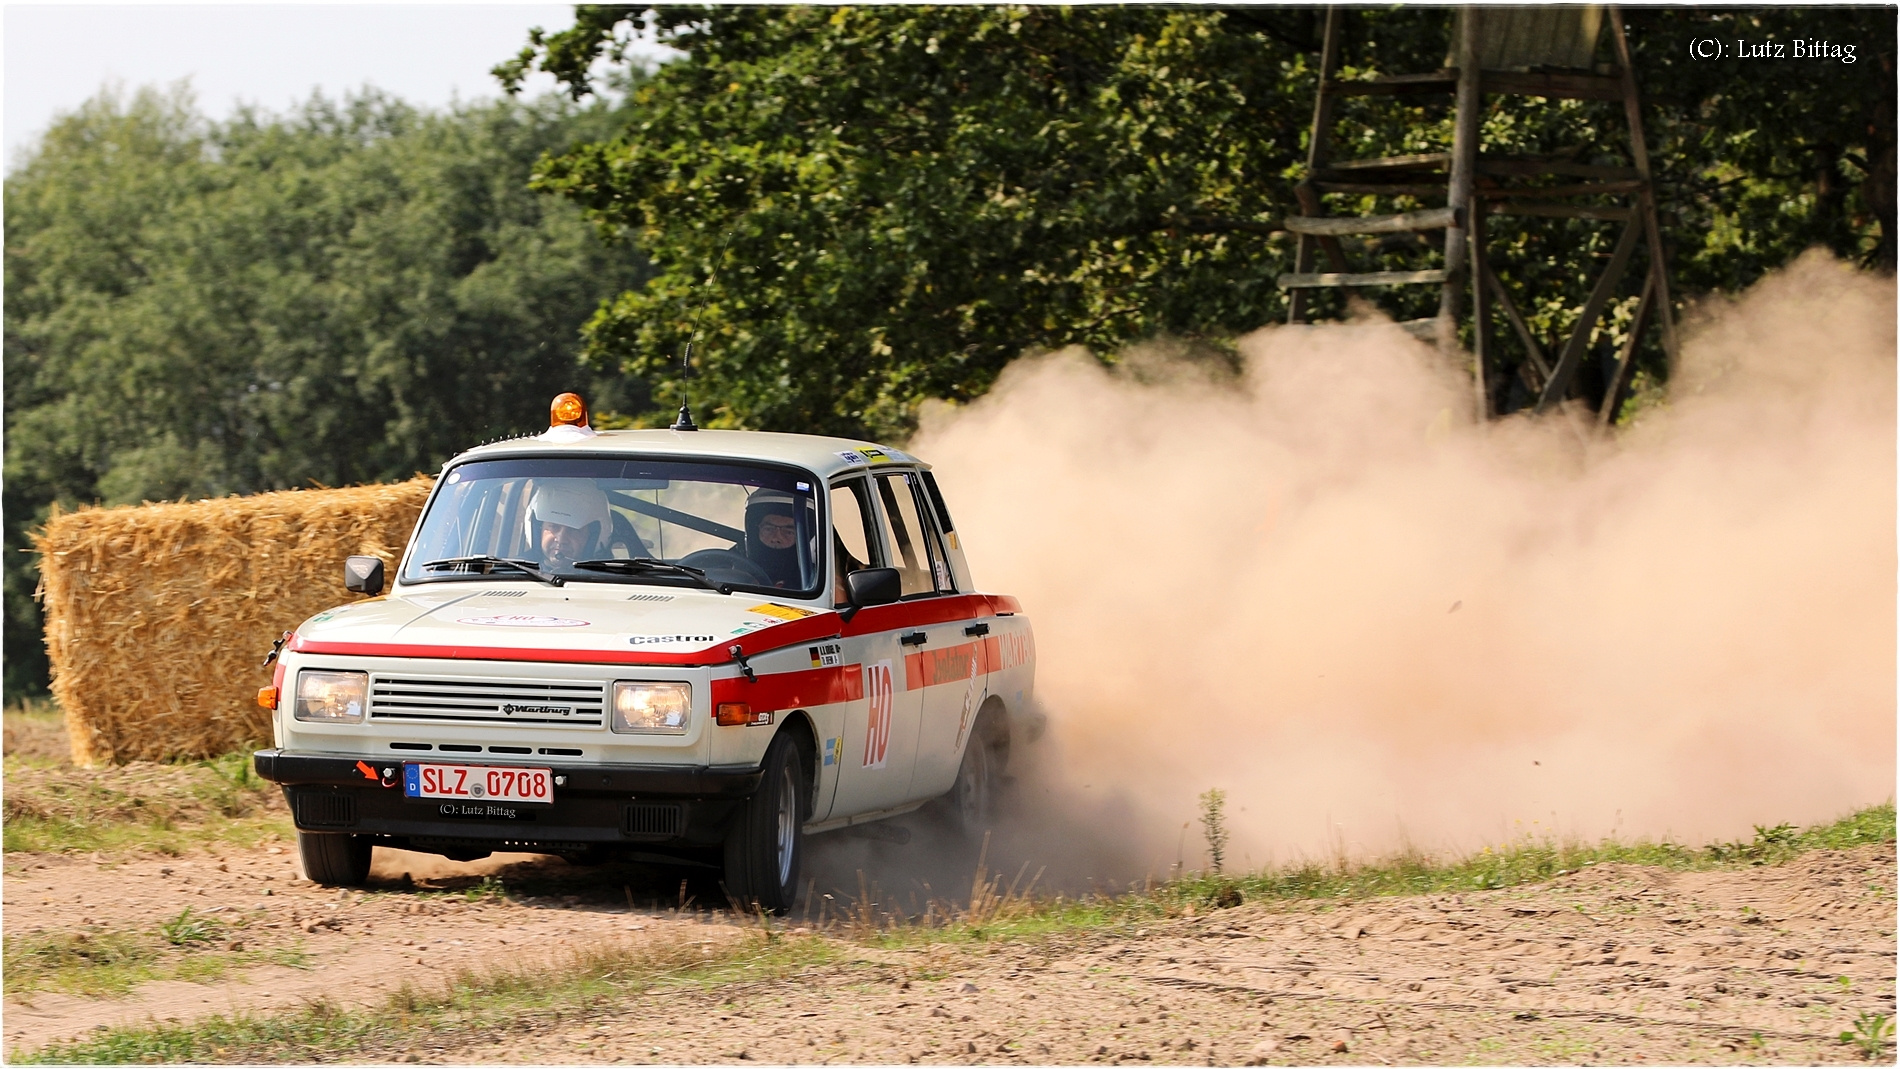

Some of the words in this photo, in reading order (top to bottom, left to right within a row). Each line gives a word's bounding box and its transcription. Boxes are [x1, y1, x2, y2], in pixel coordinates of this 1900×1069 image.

[629, 635, 714, 645] Castrol
[513, 705, 571, 716] Wartburg
[409, 783, 416, 791] D
[423, 768, 468, 795] SLZ
[487, 771, 546, 798] 0708
